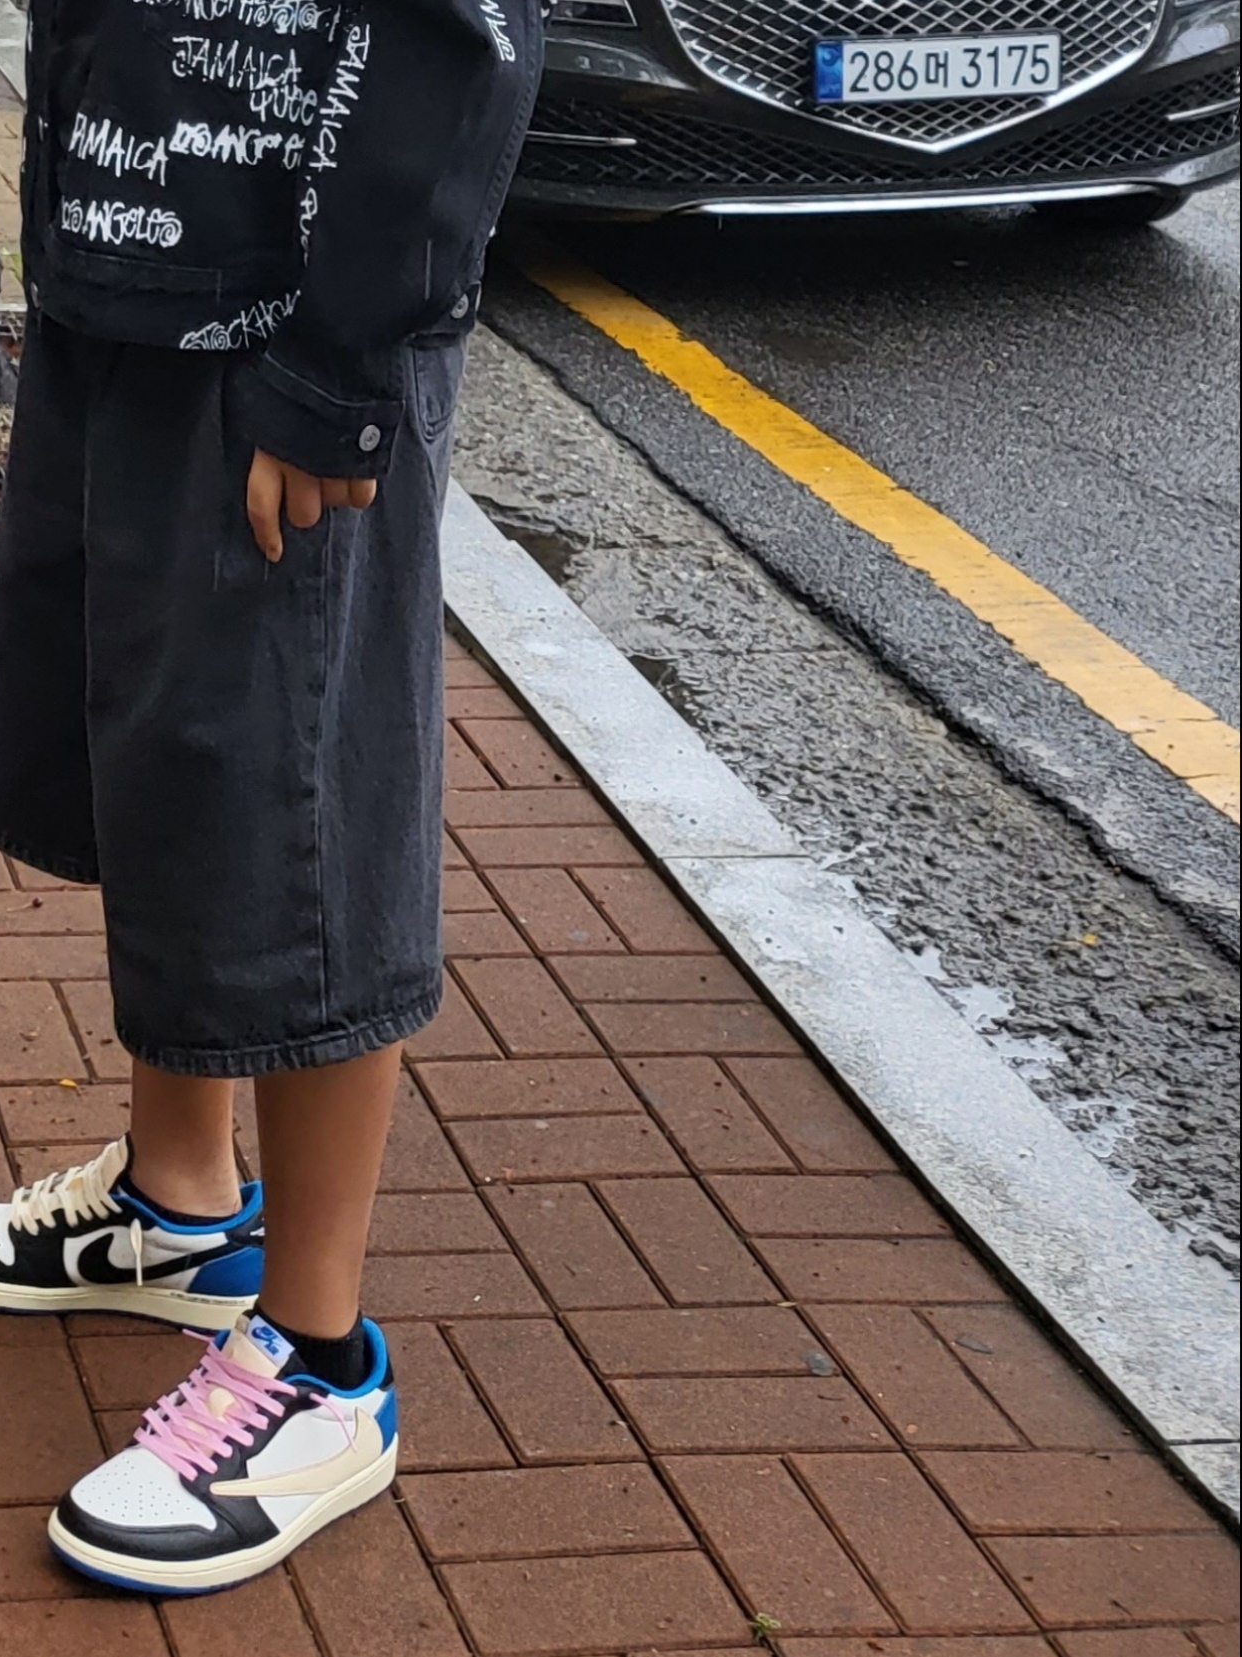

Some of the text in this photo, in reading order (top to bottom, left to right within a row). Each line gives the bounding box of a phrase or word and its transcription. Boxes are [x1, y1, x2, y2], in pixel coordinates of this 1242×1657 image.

[171, 34, 303, 92] JAMAICA
[848, 43, 1050, 93] 286머 3175
